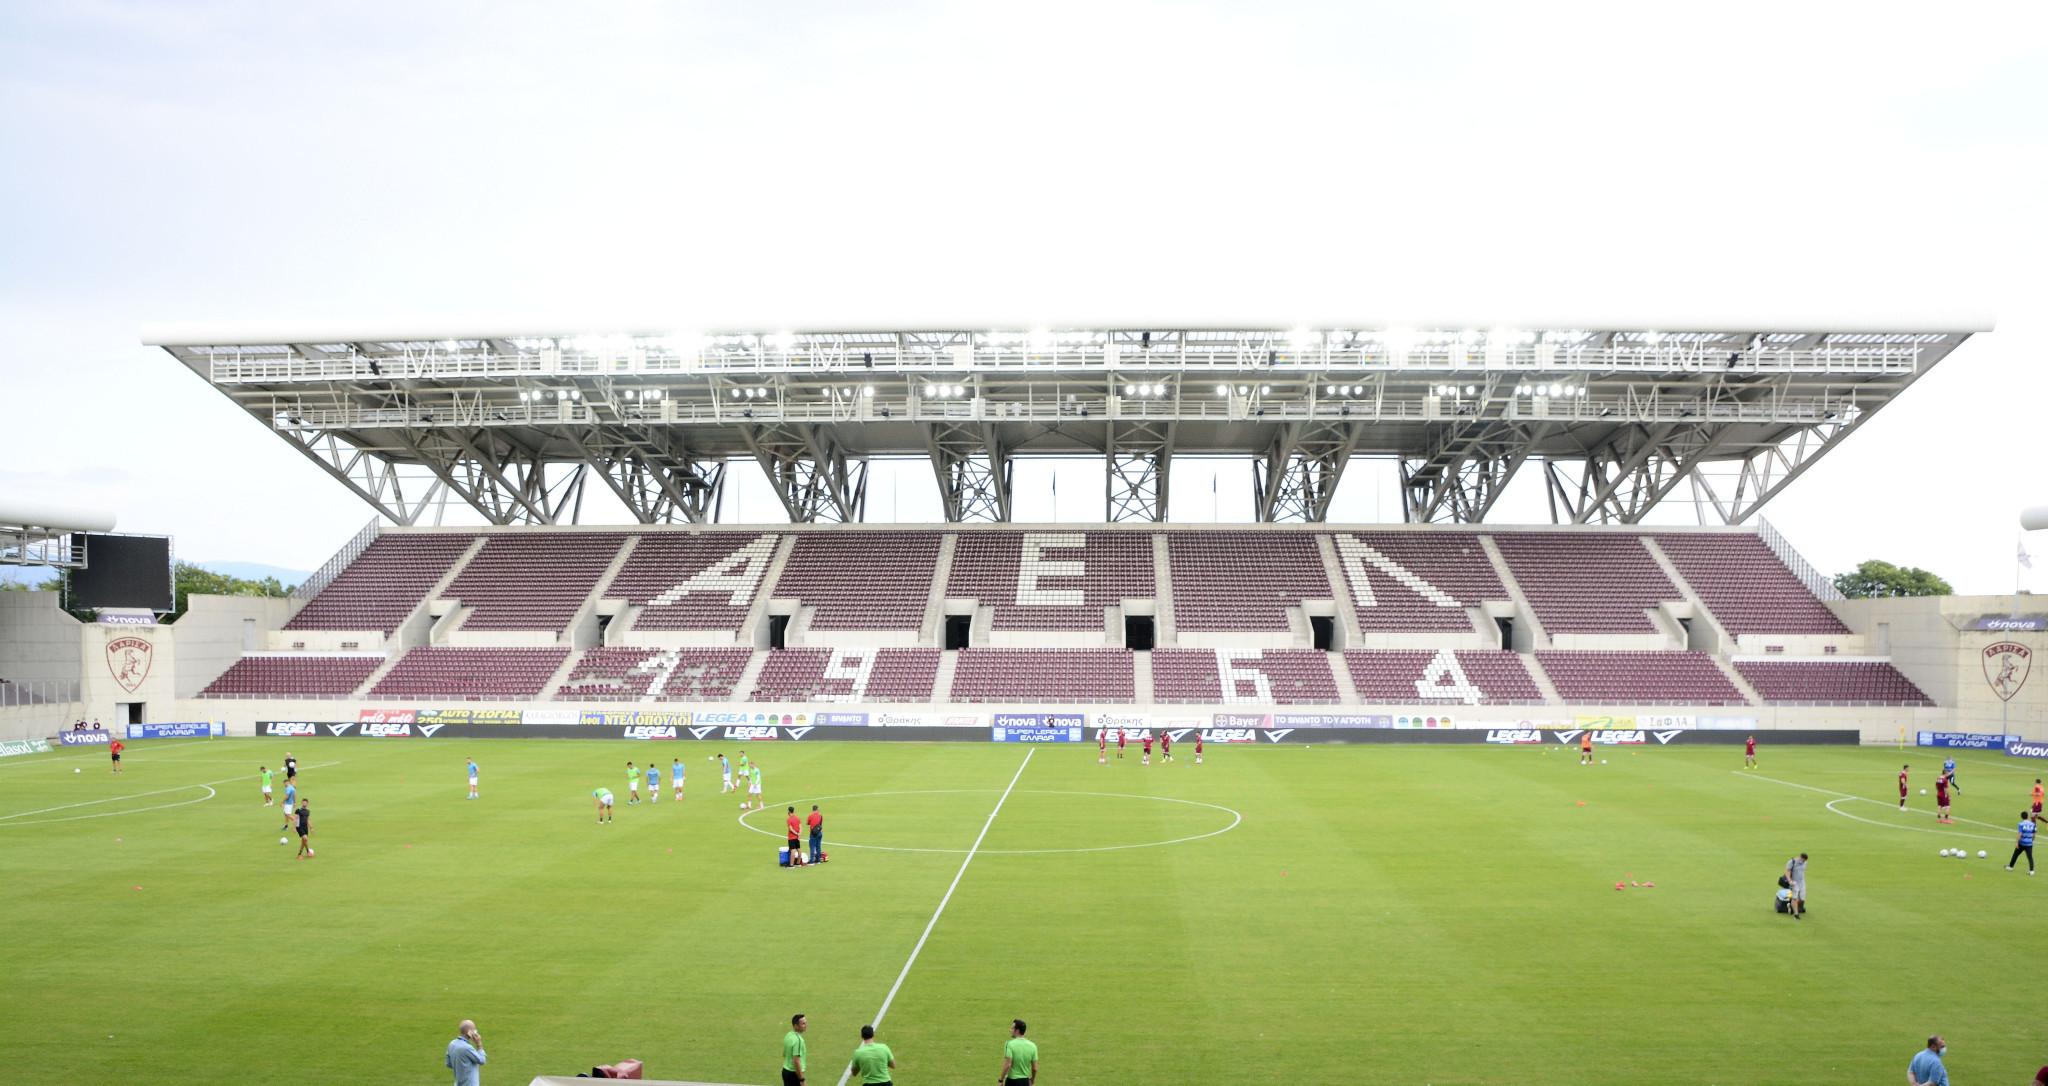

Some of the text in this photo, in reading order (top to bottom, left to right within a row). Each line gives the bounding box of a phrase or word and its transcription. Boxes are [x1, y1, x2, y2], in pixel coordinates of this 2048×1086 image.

[2000, 621, 2036, 629] nova
[113, 640, 146, 651] ΛΑΡΙΣΑ
[695, 713, 748, 723] LEGEA
[1008, 718, 1036, 726] nova
[1054, 718, 1081, 726] nova
[1229, 716, 1258, 727] Bayer
[266, 723, 316, 734] LEGEA
[359, 723, 411, 735] LEGEA
[624, 726, 677, 737] LEGEA
[724, 727, 778, 738] LEGEA
[77, 732, 108, 744] nova
[1200, 729, 1256, 740] LEGEA
[1486, 730, 1542, 741] LEGEA
[1590, 730, 1645, 742] LEGEA
[2022, 746, 2048, 757] nov
